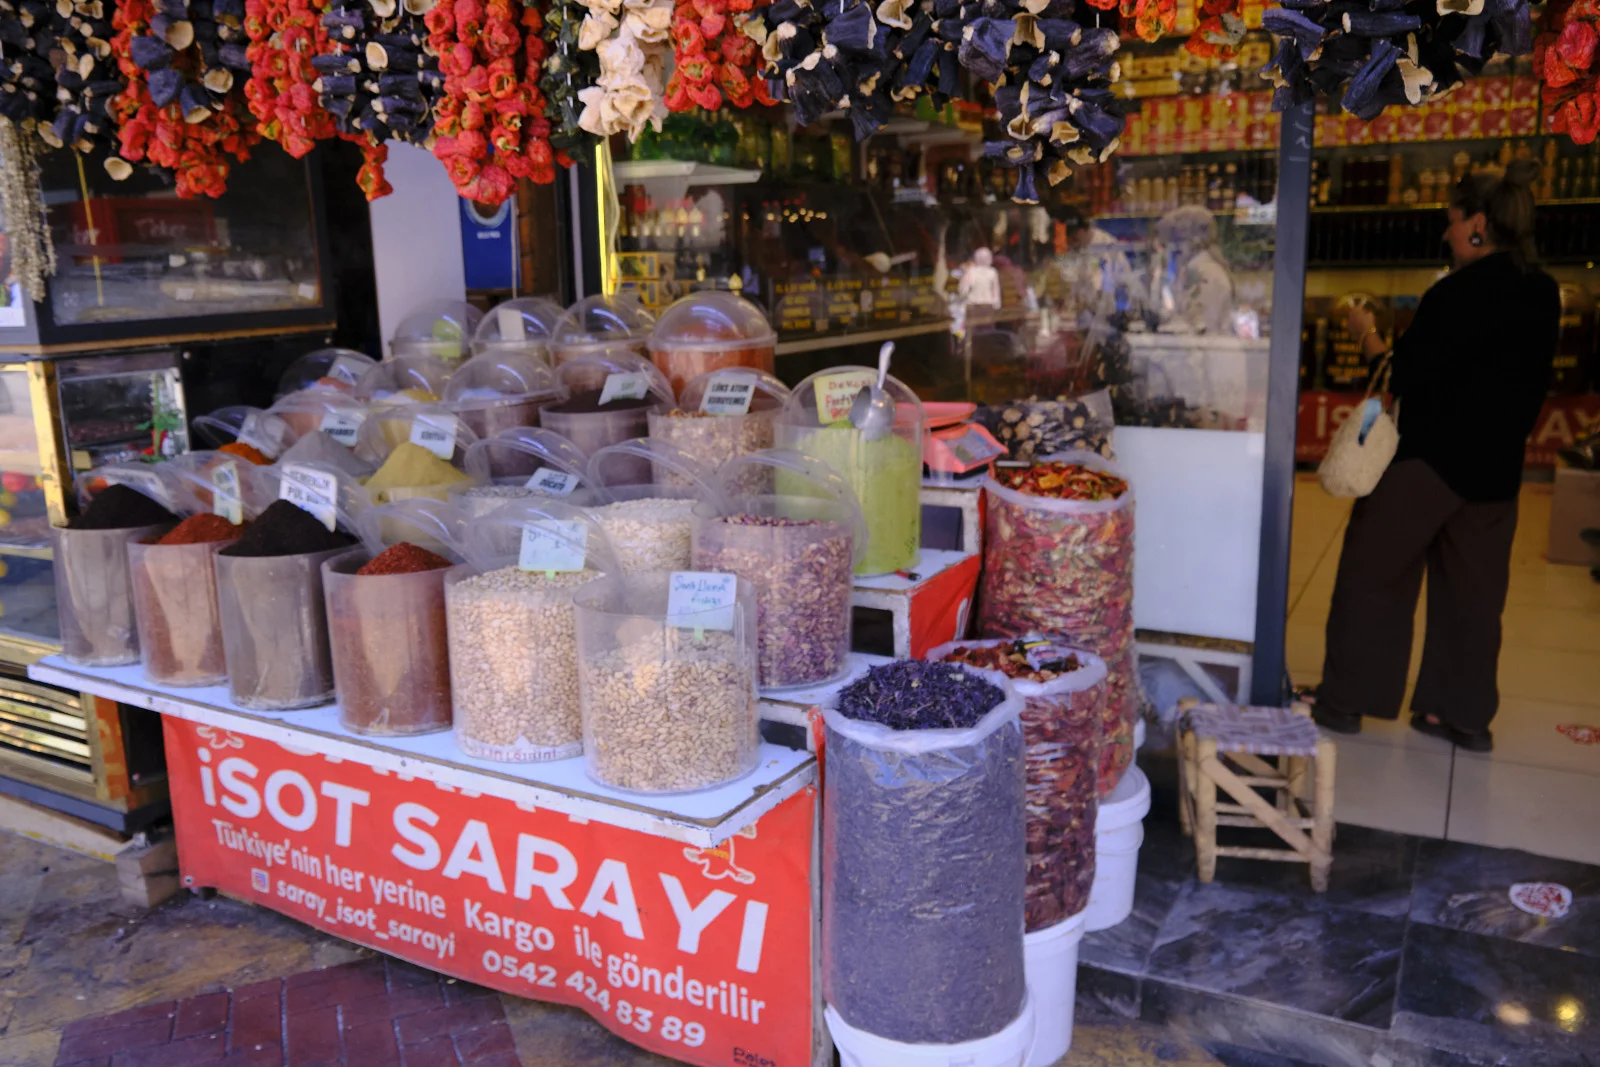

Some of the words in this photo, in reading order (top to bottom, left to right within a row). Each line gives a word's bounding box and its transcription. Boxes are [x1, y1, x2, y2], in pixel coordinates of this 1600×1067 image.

[197, 746, 370, 848] iSOT
[391, 802, 769, 973] SARAYI
[212, 819, 322, 880] Türkiye'nin
[326, 855, 364, 893] her
[370, 876, 446, 919] yerine
[464, 898, 555, 953] Kargo
[573, 925, 603, 969] ile
[607, 952, 767, 1025] gönderilir
[277, 878, 456, 958] saray_isot_sarayi
[482, 950, 557, 988] 0542
[565, 971, 611, 1013] 424
[616, 1002, 652, 1033] 83
[661, 1016, 706, 1048] 89
